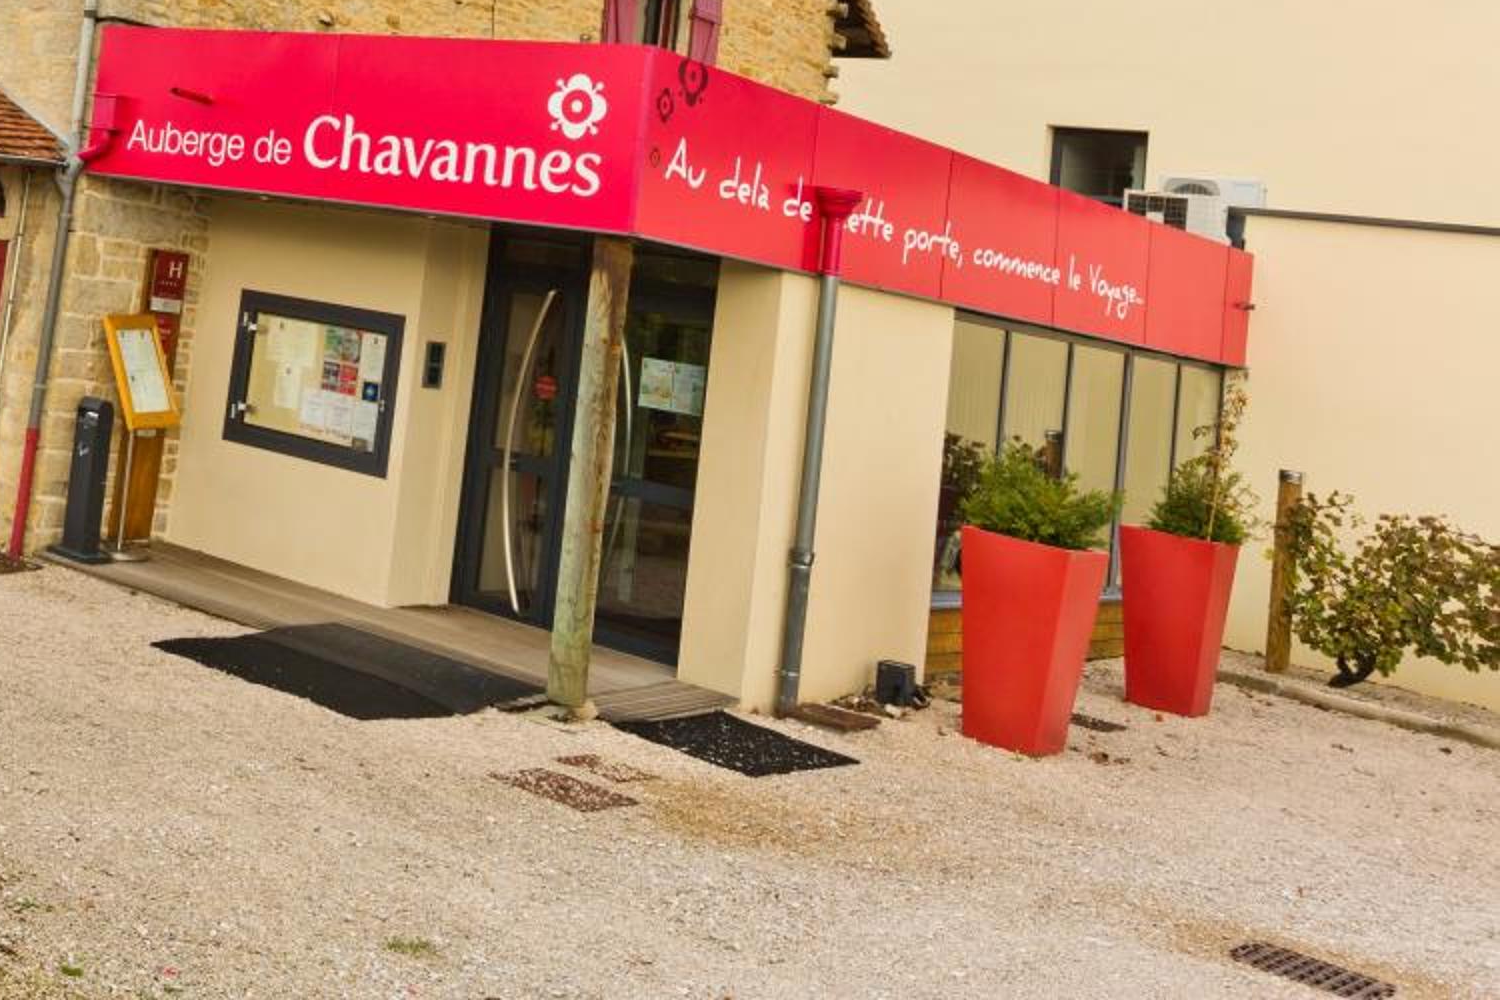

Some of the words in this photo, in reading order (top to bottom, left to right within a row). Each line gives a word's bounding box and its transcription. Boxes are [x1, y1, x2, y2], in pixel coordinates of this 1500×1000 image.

[127, 119, 244, 167] Auberge
[253, 130, 292, 165] de
[303, 113, 602, 197] Chavannes
[664, 136, 706, 189] Au
[718, 156, 769, 211] delà
[782, 176, 813, 222] de
[844, 198, 894, 242] ette
[902, 220, 963, 269] porte,
[972, 247, 1061, 285] commence
[1067, 253, 1081, 291] le
[168, 261, 184, 279] H
